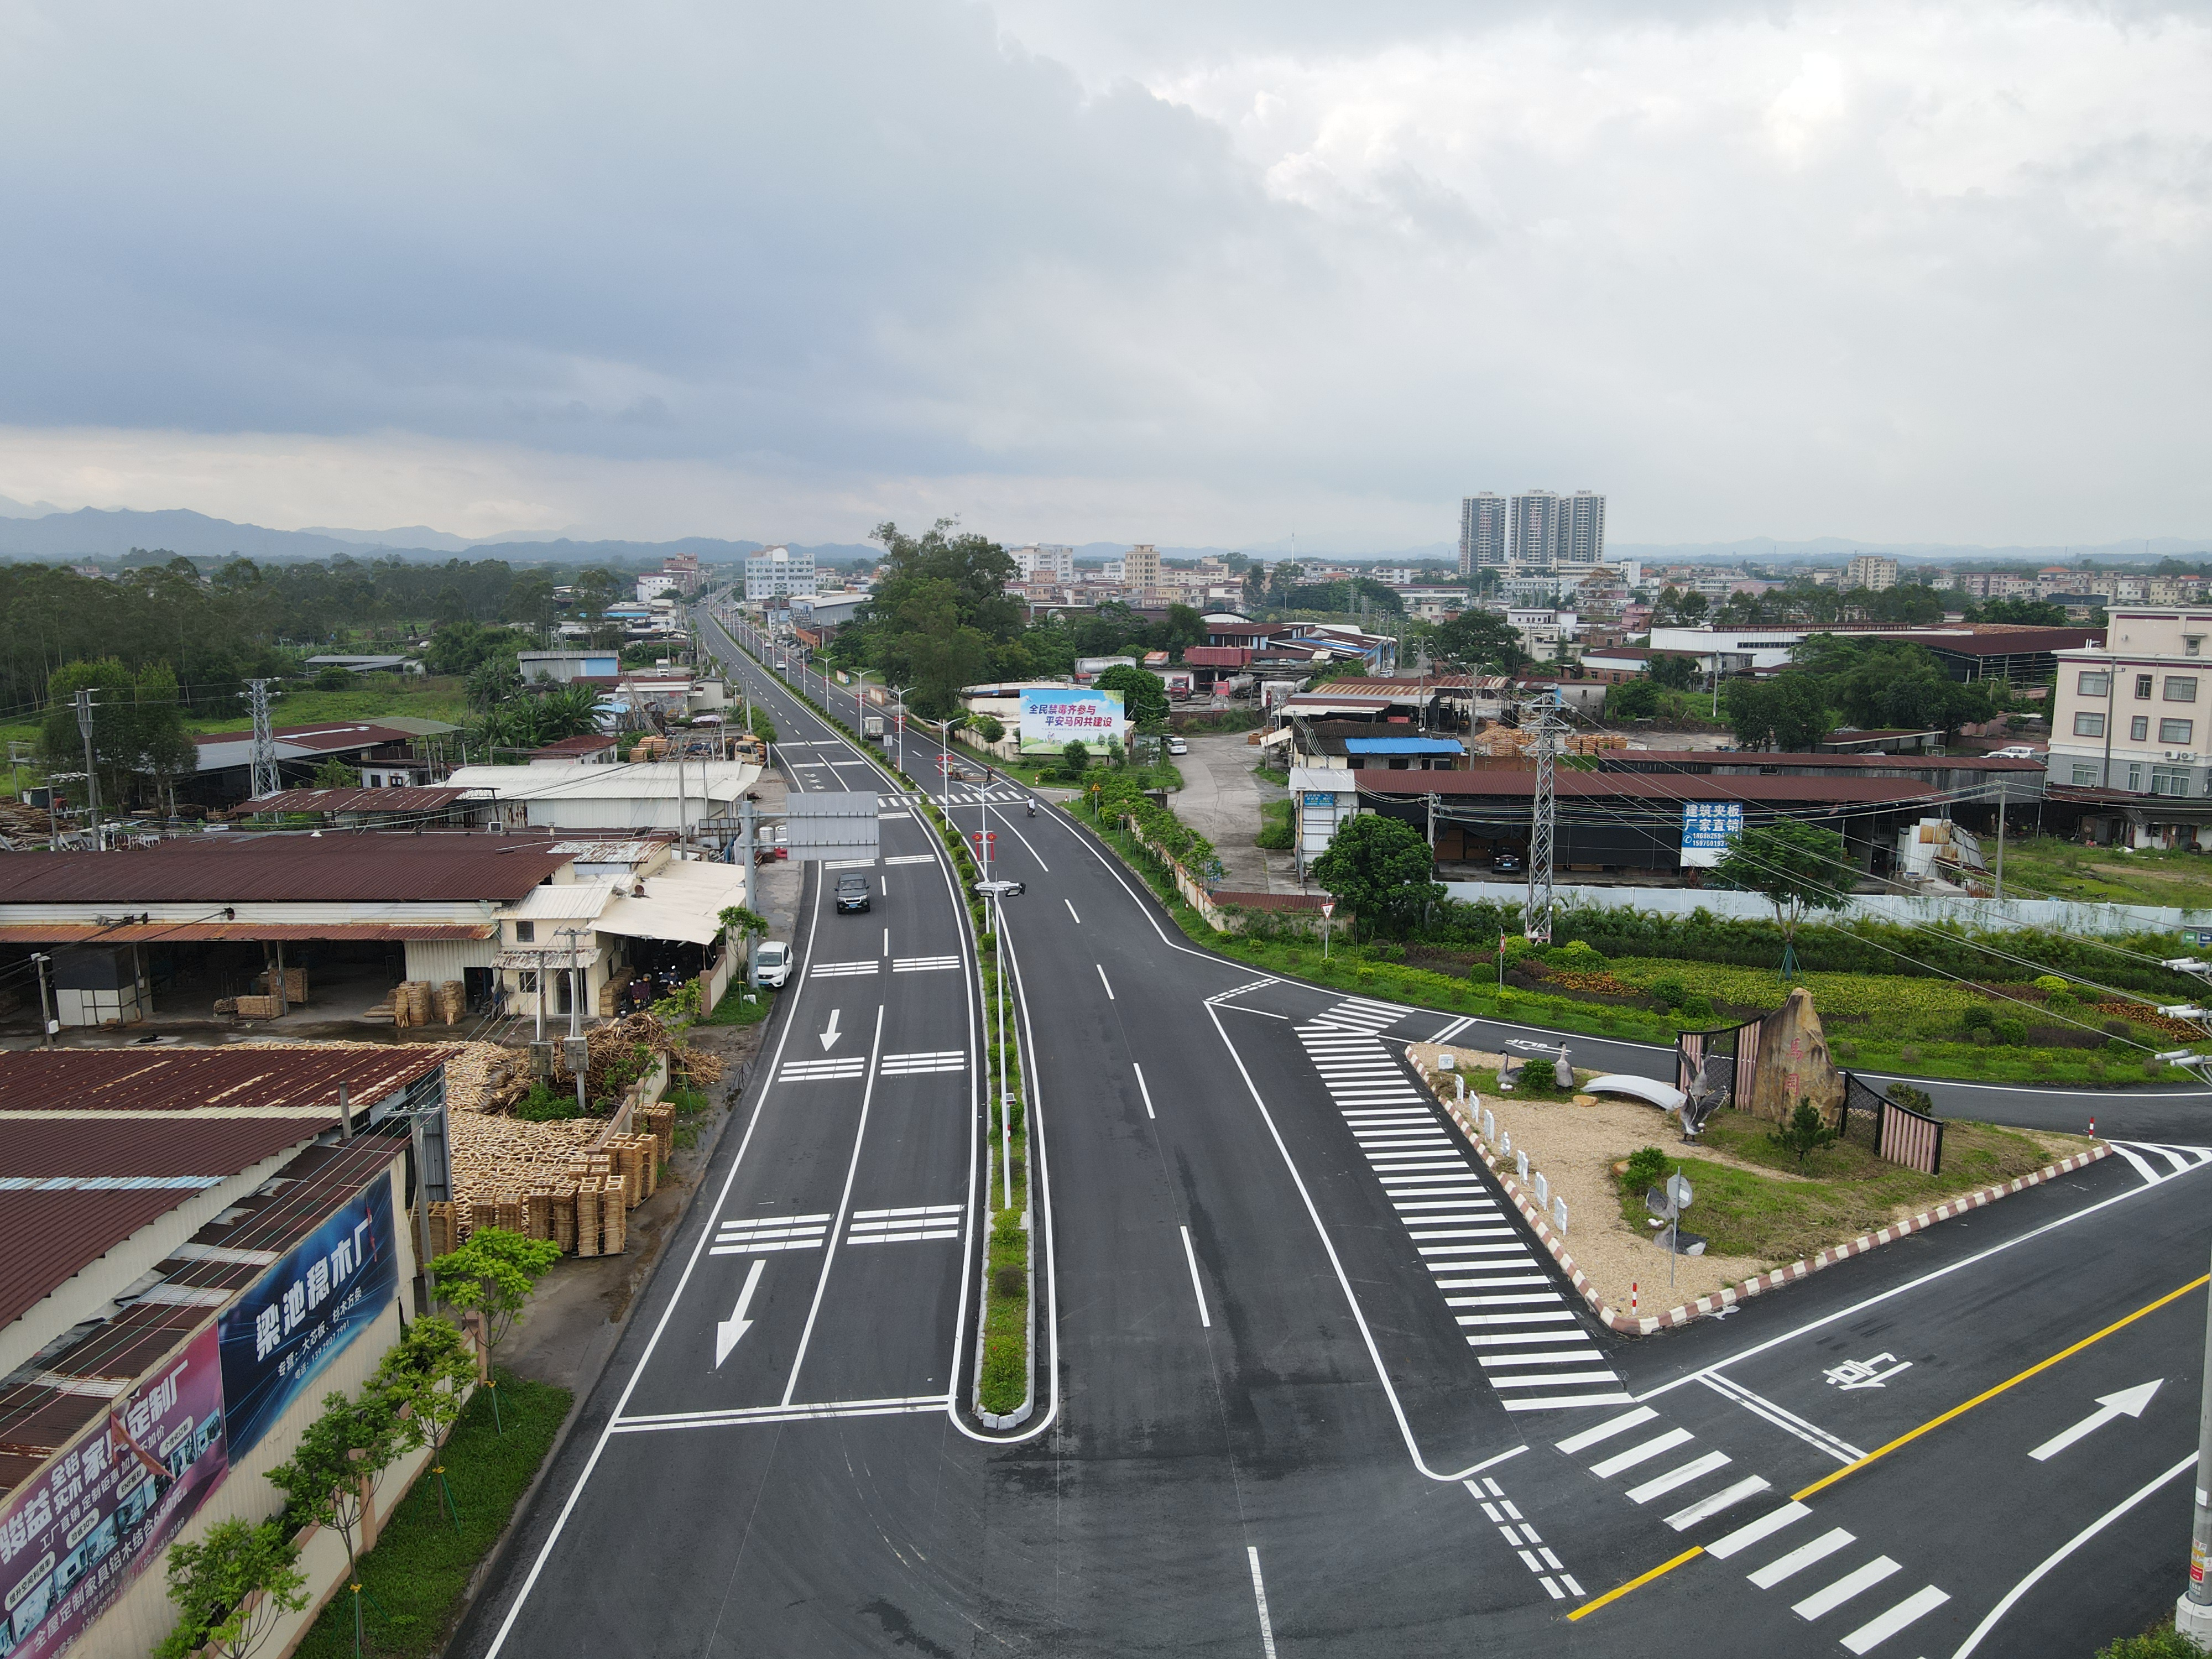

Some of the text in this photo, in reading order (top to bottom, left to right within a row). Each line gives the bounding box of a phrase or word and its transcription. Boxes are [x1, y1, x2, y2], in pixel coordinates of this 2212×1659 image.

[1029, 704, 1096, 715] 全民禁毒齐参与
[1045, 716, 1113, 727] 平安马冈共建设
[1686, 804, 1740, 817] 建筑夹板
[1684, 818, 1739, 832] 厂家直销
[255, 1214, 372, 1362] 梁池稳木厂
[40, 1507, 80, 1553] 工厂直销
